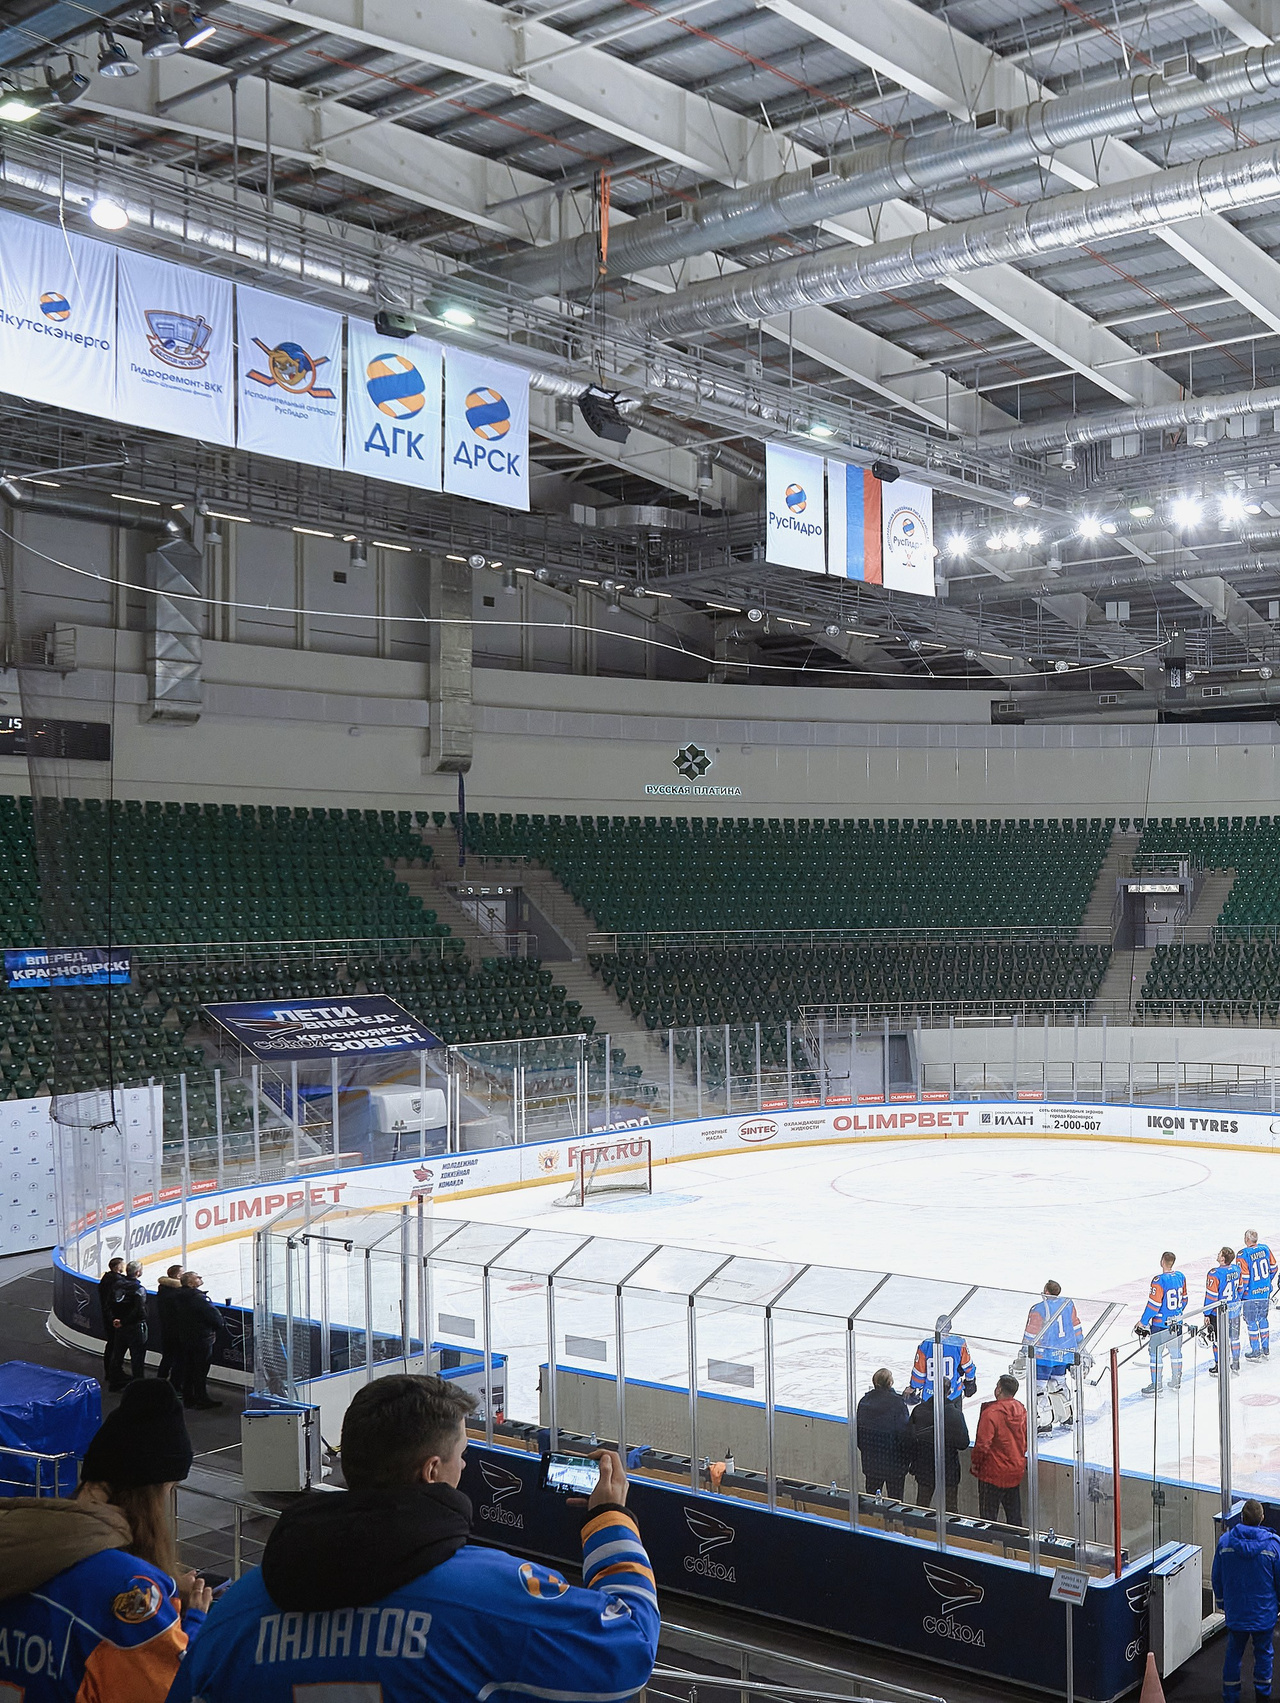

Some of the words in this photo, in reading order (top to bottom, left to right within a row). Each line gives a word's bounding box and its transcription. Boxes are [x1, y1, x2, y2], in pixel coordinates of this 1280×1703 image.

[364, 422, 426, 461] ДГК
[452, 440, 521, 477] ДРСК
[768, 511, 823, 537] РусГидро
[645, 784, 692, 795] РУССКАЯ
[693, 785, 742, 796] ПЛАТИНА
[12, 960, 131, 980] КРАСНОЯРСК!
[272, 1005, 359, 1022] ЛЕТИ
[295, 1023, 417, 1041] КРАСНОЯРСК
[328, 1032, 427, 1052] ЗОВЕТ!
[740, 1125, 776, 1136] SINTEC
[833, 1111, 969, 1131] OLIMPBET
[994, 1115, 1034, 1126] ИЛАН
[1054, 1120, 1101, 1130] 2-000-007
[1147, 1115, 1185, 1130] IKON
[1189, 1118, 1239, 1133] TYRES
[195, 1182, 348, 1230] OLIMPBET
[1252, 1258, 1269, 1281] 10
[1222, 1279, 1240, 1301] 47
[1056, 1313, 1066, 1338] 1
[255, 1607, 433, 1665] ПАЛАТОВ
